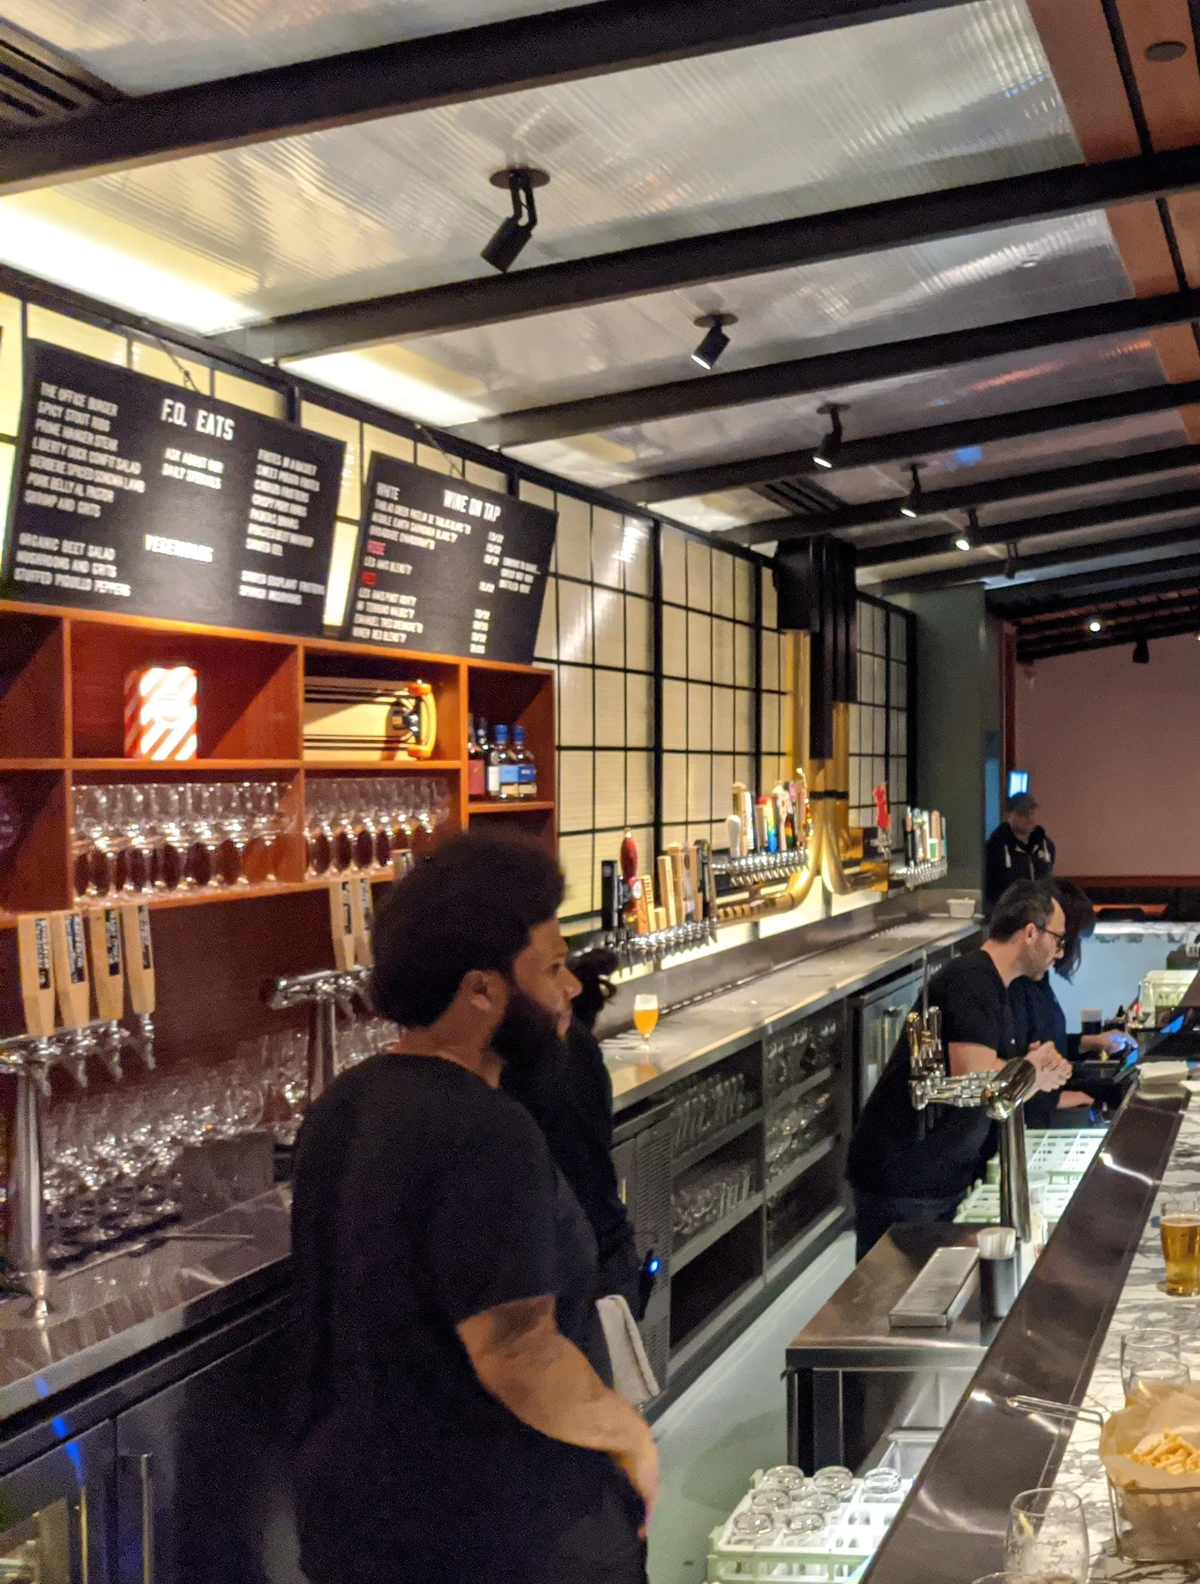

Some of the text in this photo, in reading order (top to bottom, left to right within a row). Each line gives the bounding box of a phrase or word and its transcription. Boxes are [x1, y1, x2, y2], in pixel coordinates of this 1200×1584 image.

[196, 409, 234, 440] EATS
[443, 489, 501, 522] WINE ON TAP
